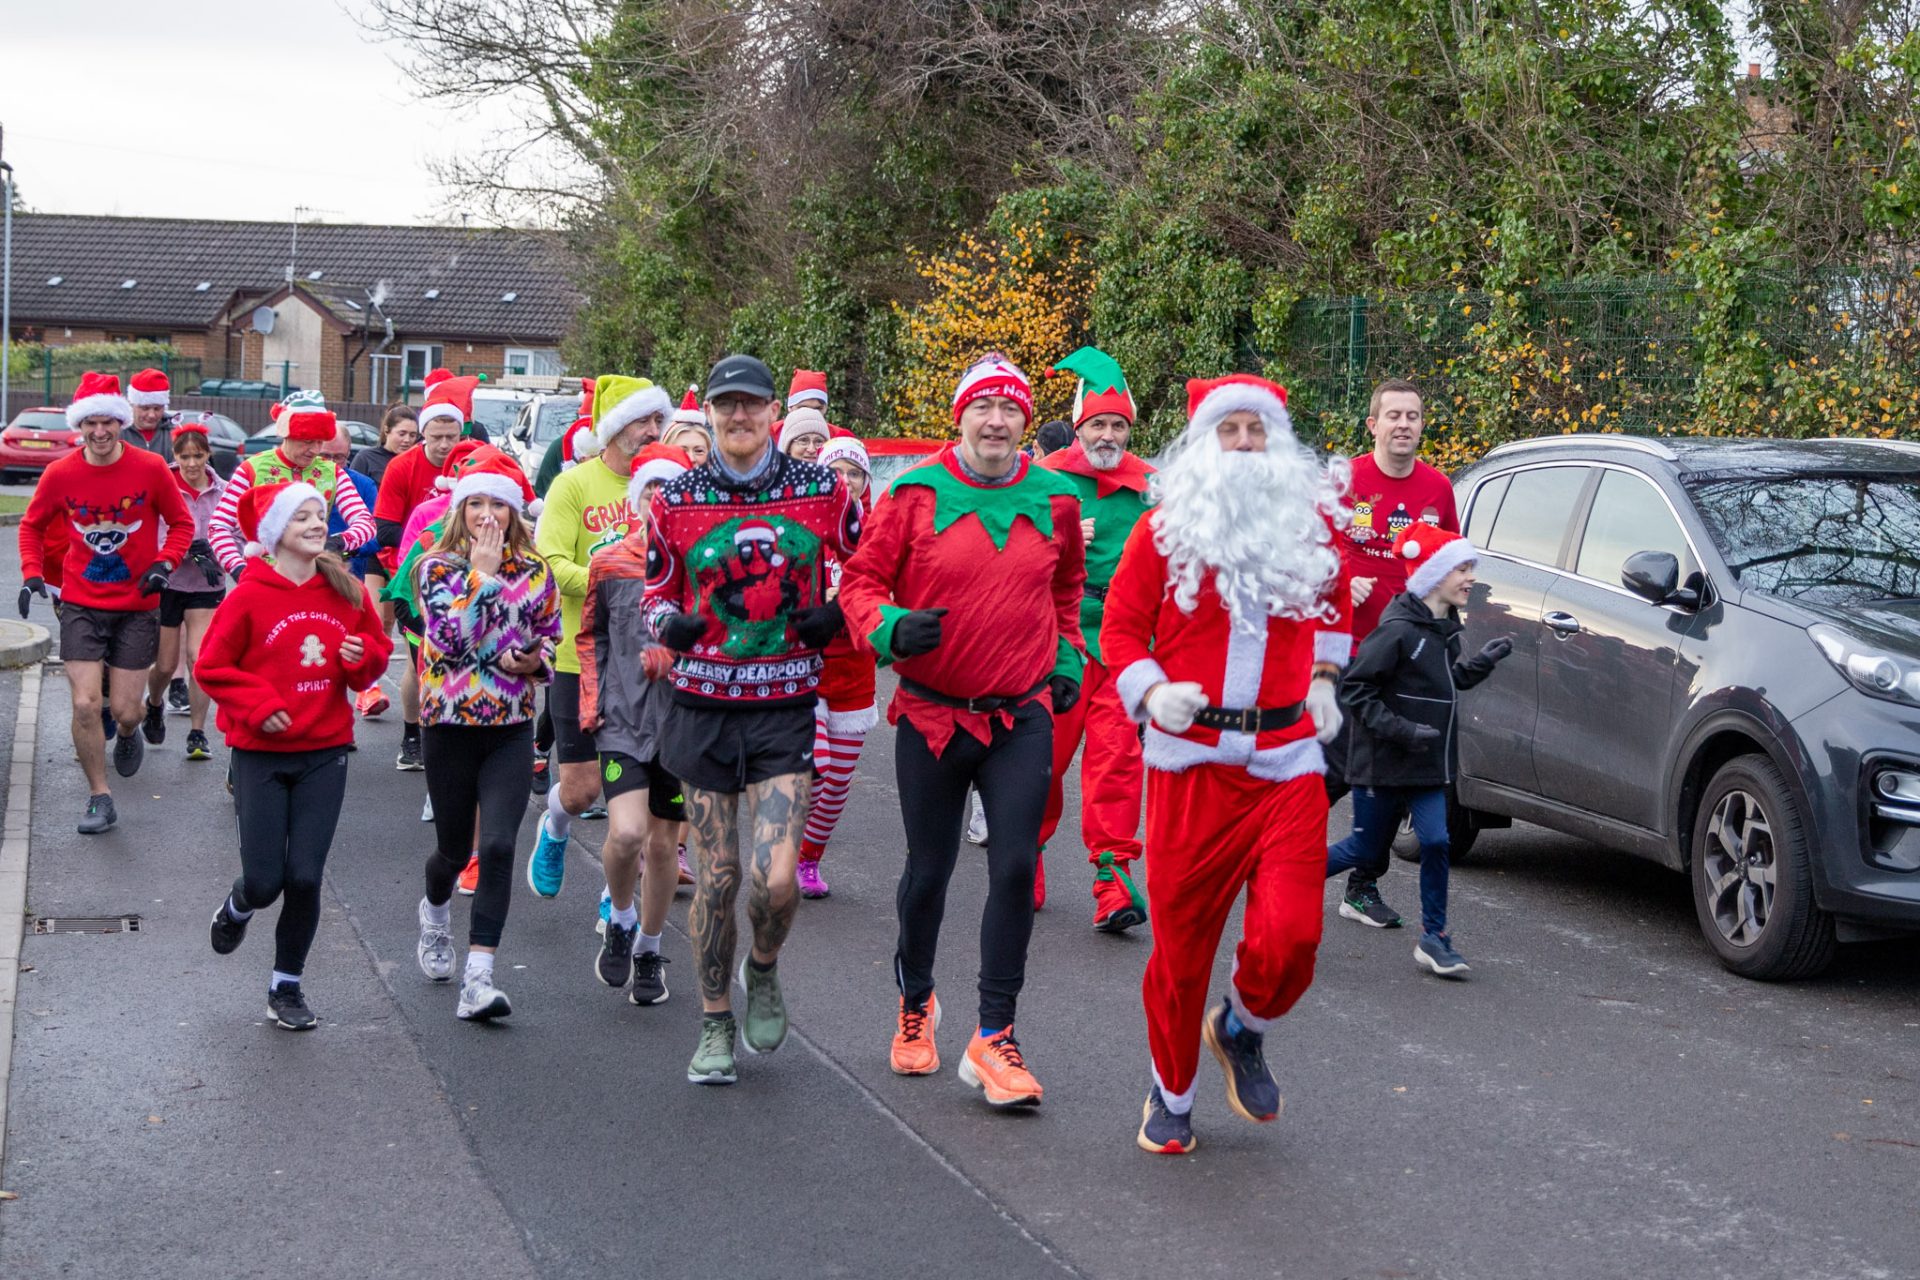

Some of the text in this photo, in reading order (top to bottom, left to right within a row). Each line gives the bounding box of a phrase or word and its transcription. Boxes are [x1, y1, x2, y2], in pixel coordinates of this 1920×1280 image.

[1003, 384, 1033, 408] Nav
[1382, 549, 1394, 559] th
[264, 611, 348, 645] TASTE THE CHRISTM
[686, 659, 812, 682] MERRY DEADPOOL
[297, 679, 331, 692] SPIRIT
